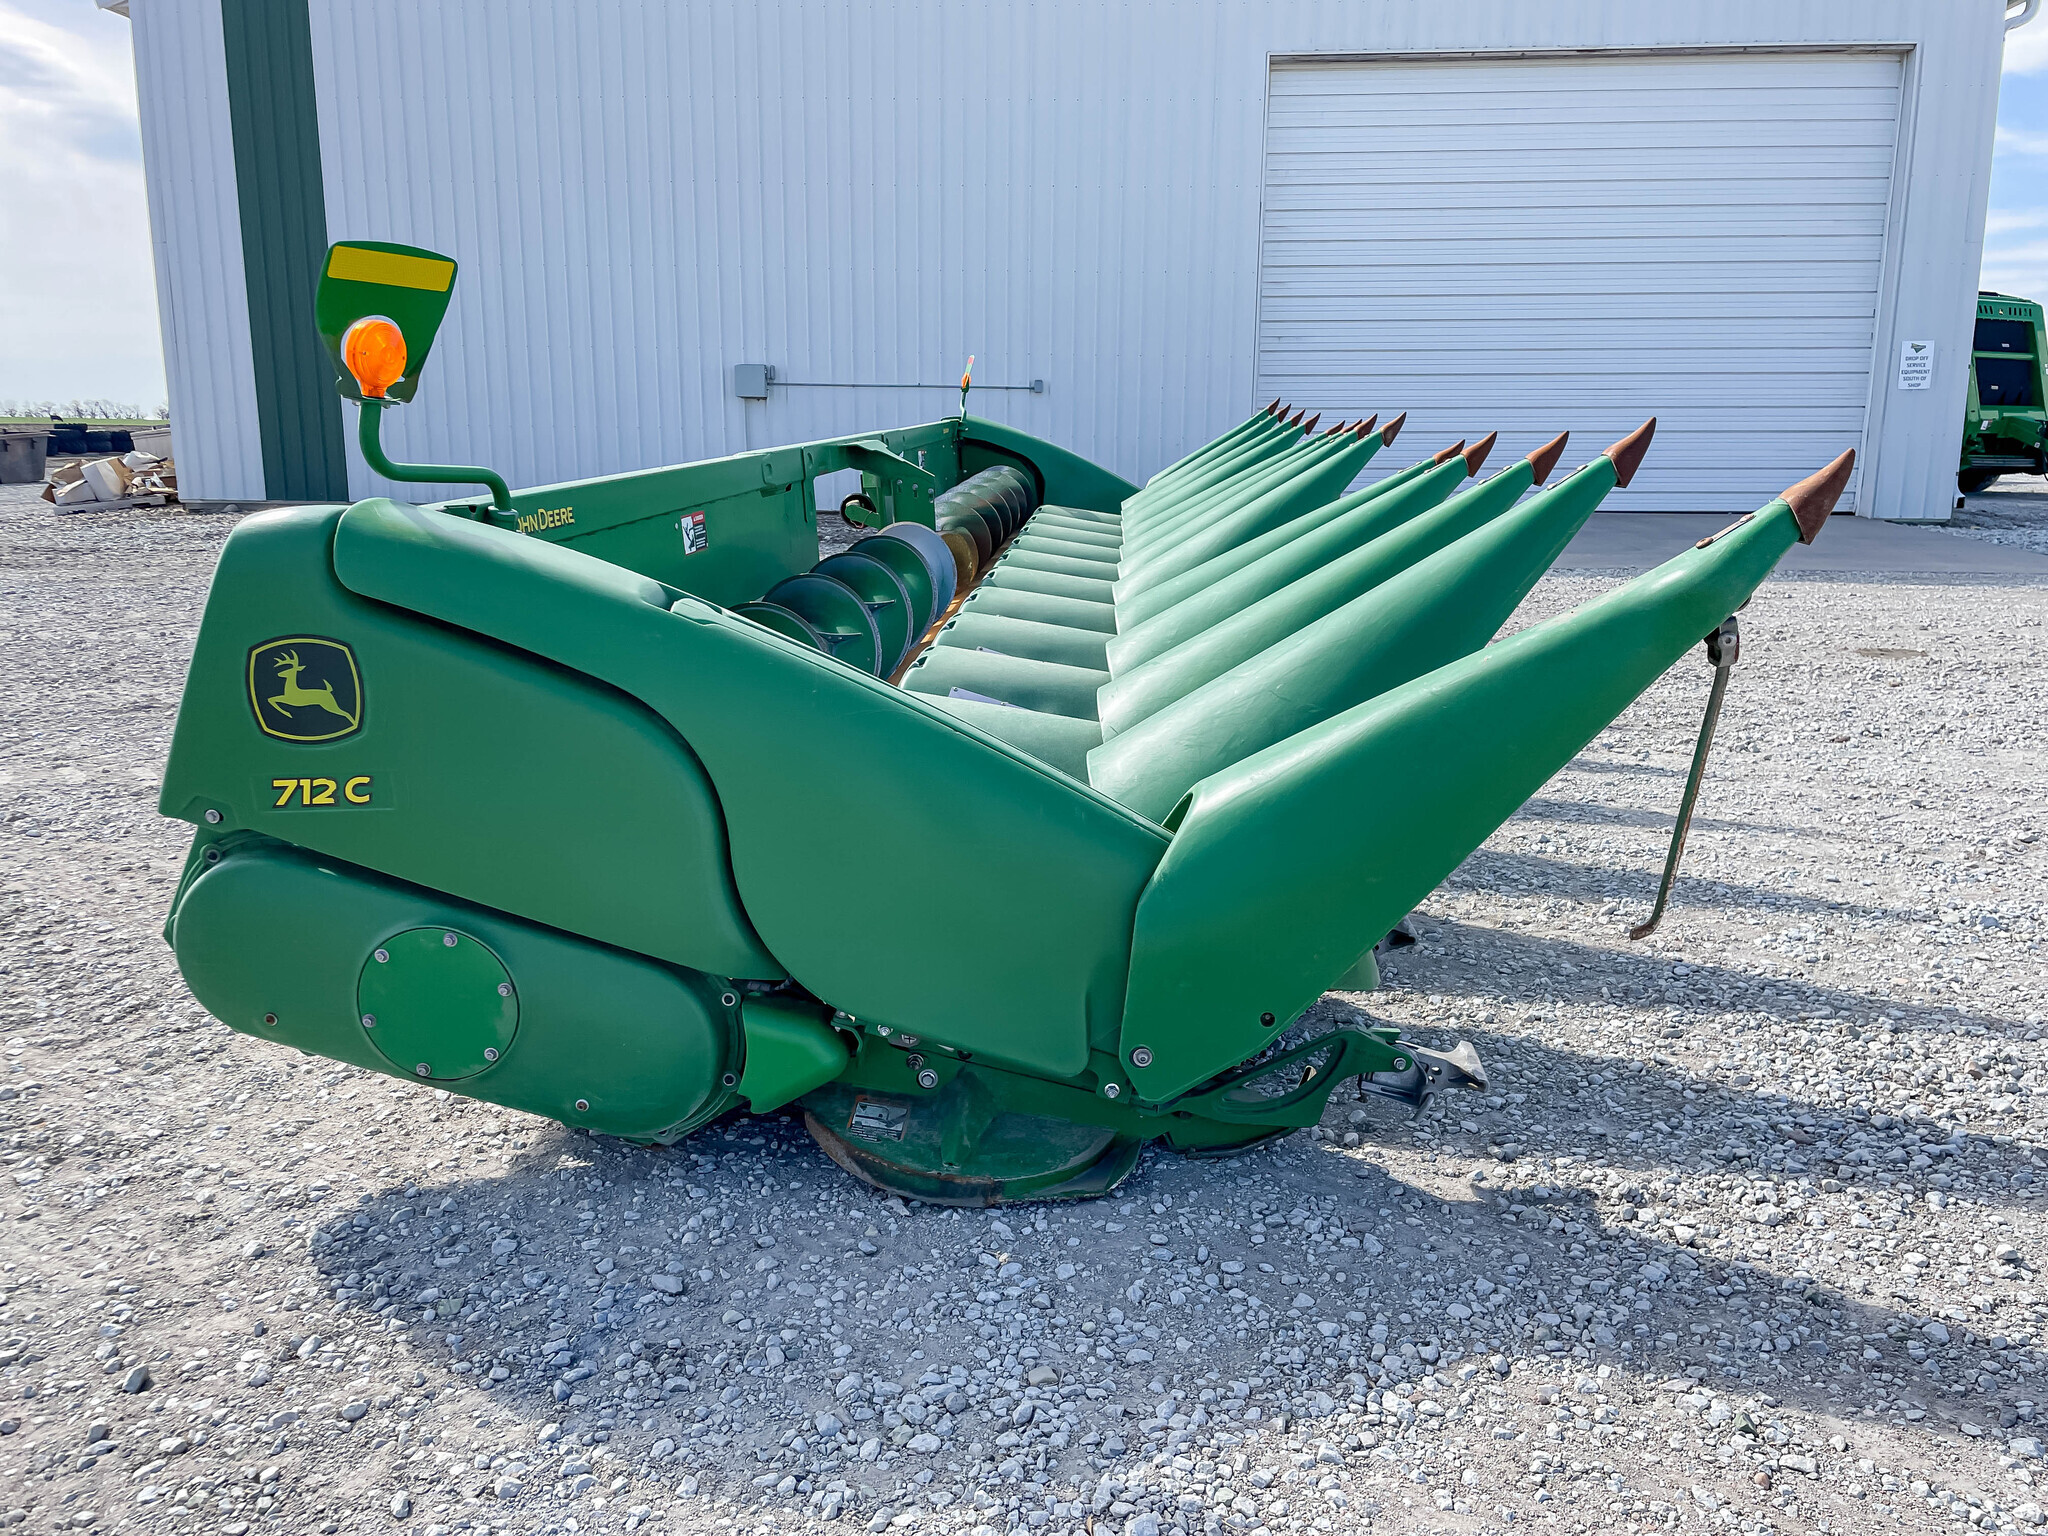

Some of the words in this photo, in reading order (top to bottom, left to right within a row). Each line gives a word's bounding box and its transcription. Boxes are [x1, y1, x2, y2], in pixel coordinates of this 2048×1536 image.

[538, 506, 576, 530] DEERE
[272, 778, 337, 806] 712
[344, 776, 371, 804] C
